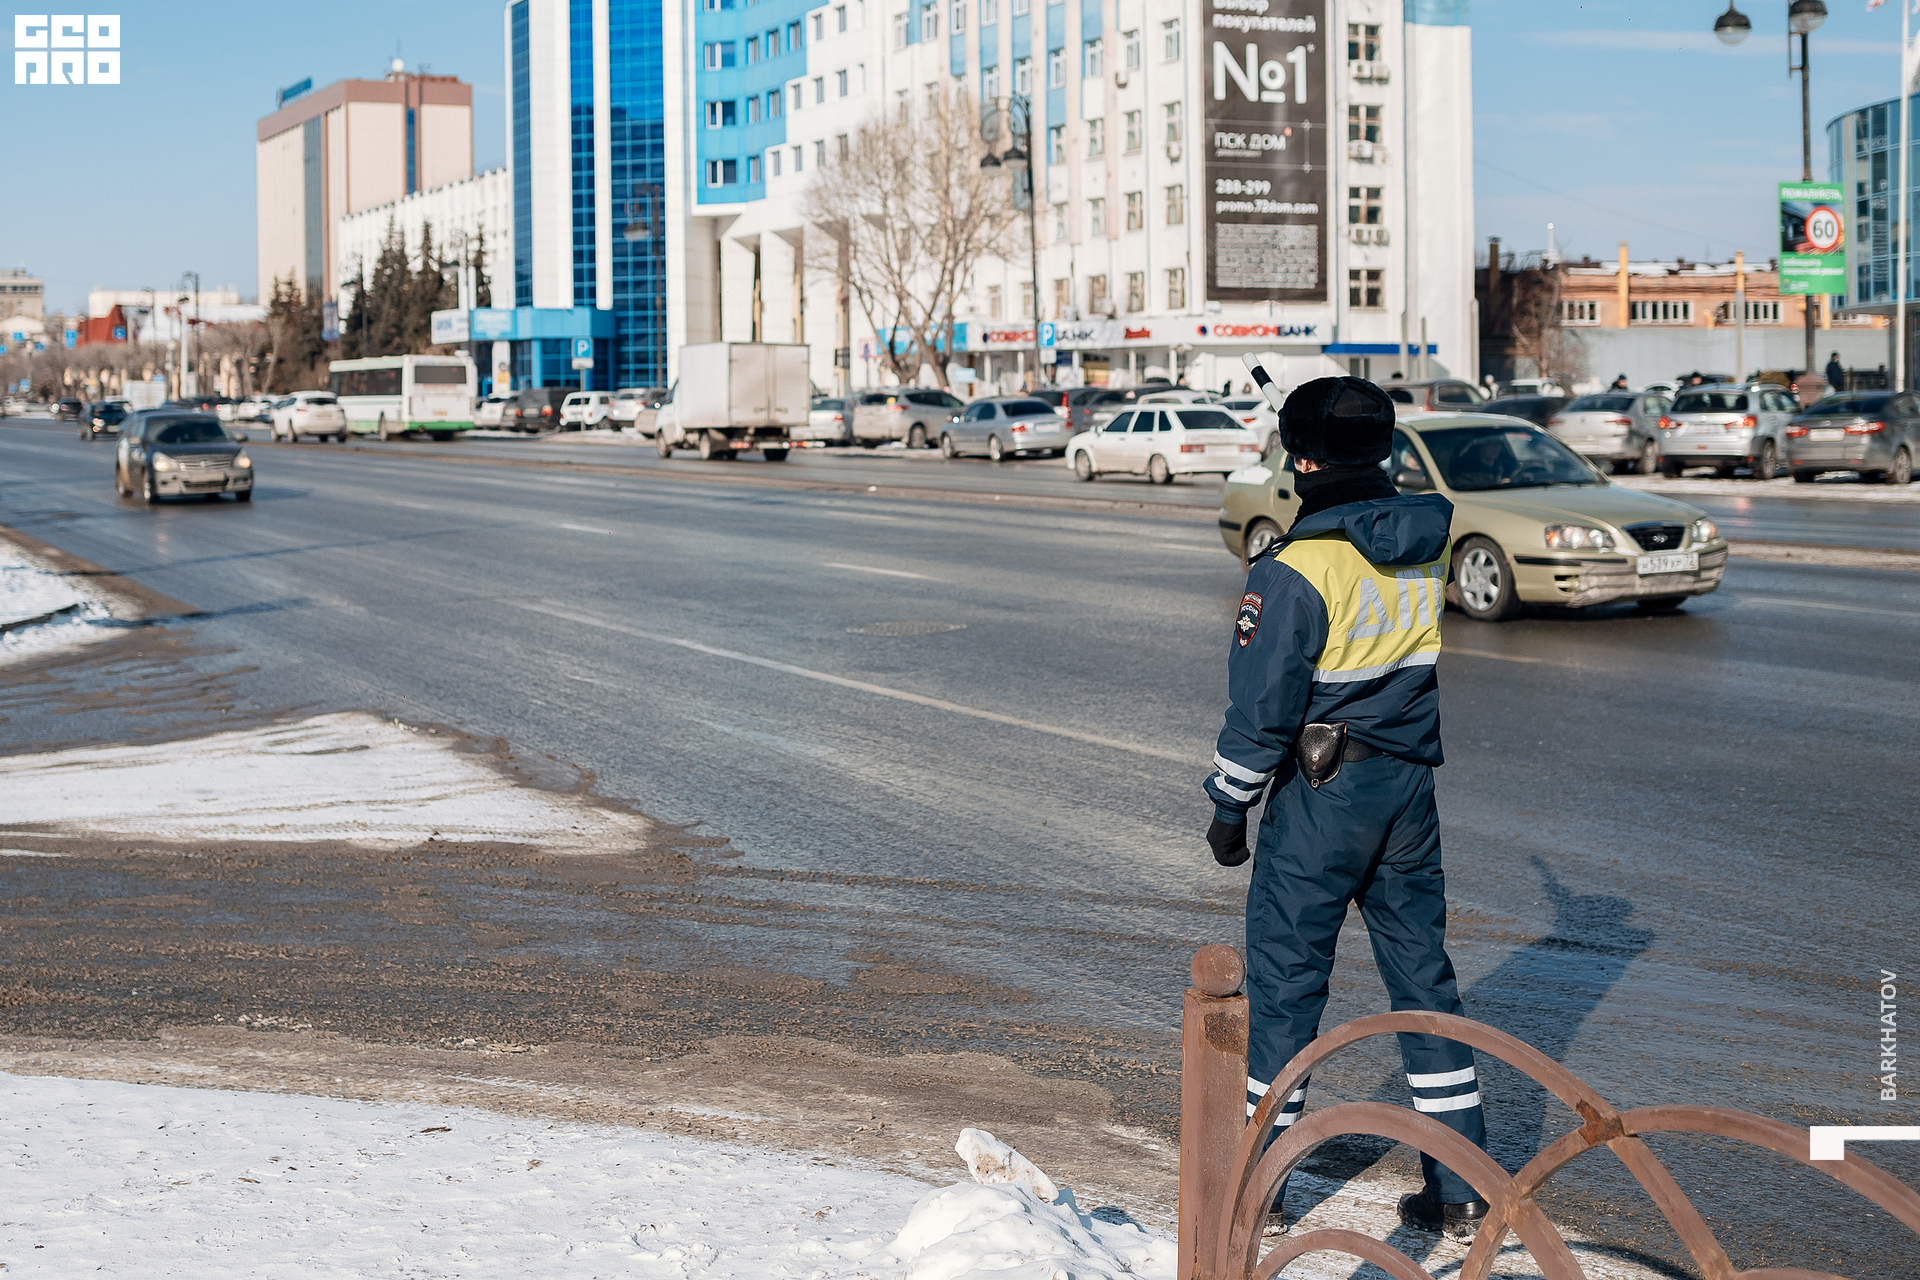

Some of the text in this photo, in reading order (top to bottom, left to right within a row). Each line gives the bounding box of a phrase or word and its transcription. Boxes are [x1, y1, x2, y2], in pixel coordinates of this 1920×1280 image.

[1213, 14, 1316, 33] покупателей
[1215, 132, 1287, 151] ПСК ДОМ
[1813, 220, 1835, 239] 60
[1213, 324, 1317, 337] СОВКОМБАНК
